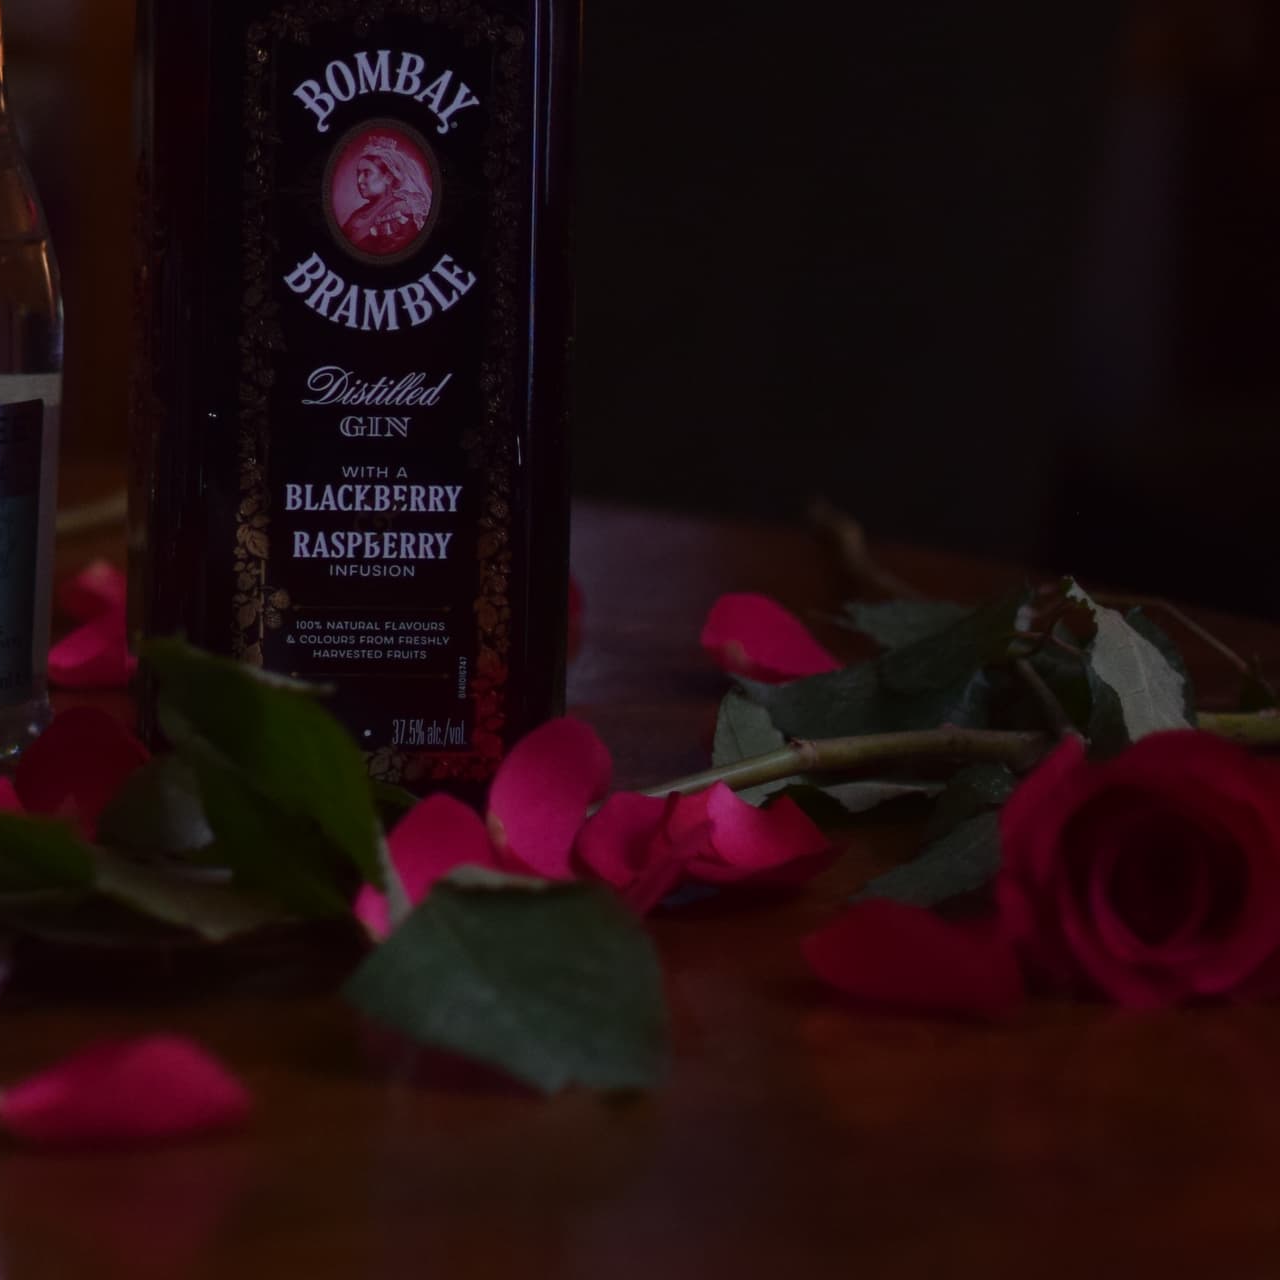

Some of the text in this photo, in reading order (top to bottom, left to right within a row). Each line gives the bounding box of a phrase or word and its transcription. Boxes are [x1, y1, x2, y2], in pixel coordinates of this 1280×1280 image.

[292, 49, 481, 135] BOMBAY
[282, 251, 478, 332] BRAMBLE
[300, 364, 454, 407] Distilled
[339, 415, 414, 439] GIN
[341, 465, 410, 480] WITH A
[284, 484, 464, 513] BLACKBERRY
[291, 531, 455, 561] RASPBERRY
[327, 564, 417, 579] INFUSION
[296, 619, 447, 632] 100% NATURAL FLAVOURS
[299, 634, 356, 645] COLOURS
[359, 634, 395, 646] FROM
[397, 635, 451, 646] FRESHLY
[312, 649, 428, 660] HARVESTED FRUITS
[391, 718, 425, 746] 37.5%
